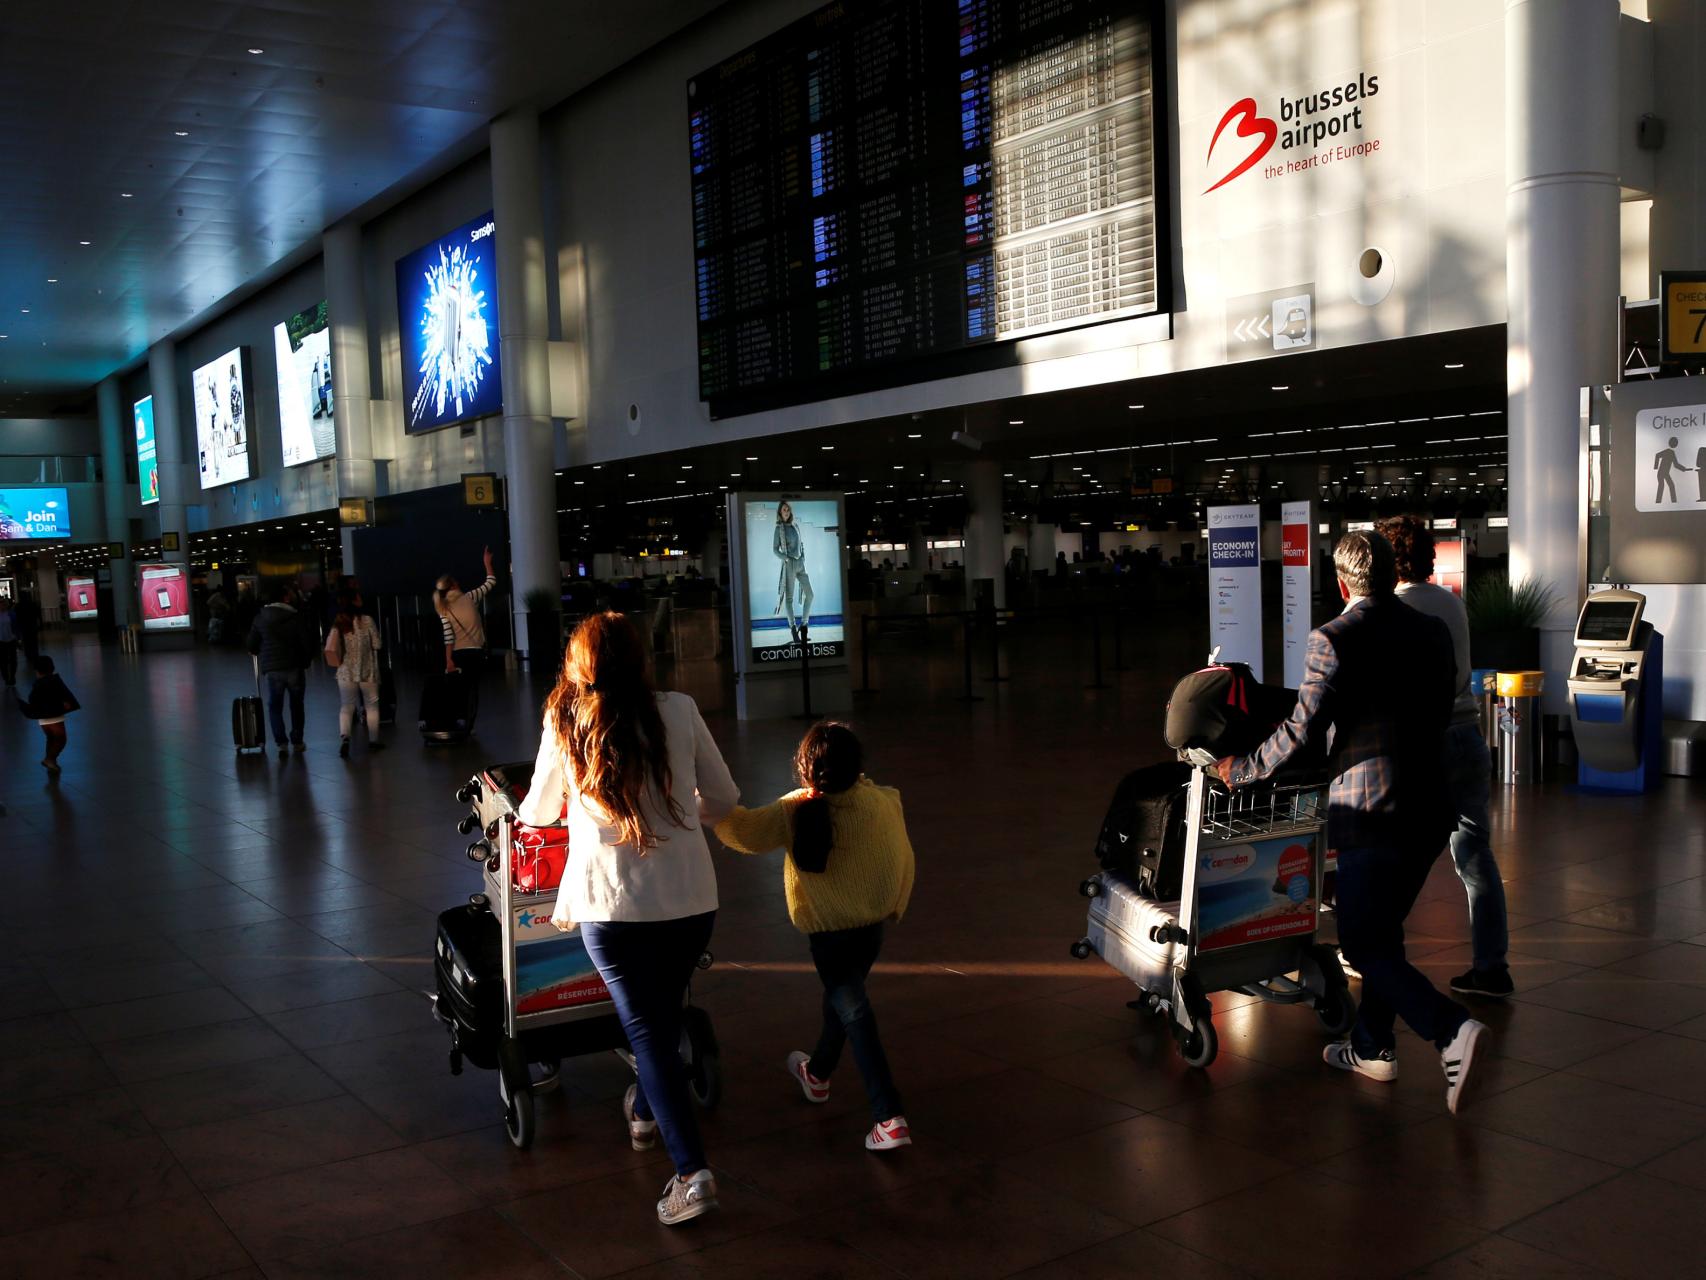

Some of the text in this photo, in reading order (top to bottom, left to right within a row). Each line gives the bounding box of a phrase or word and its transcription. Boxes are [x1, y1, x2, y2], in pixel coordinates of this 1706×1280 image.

[1281, 72, 1379, 122] brussels
[1281, 105, 1362, 150] airport
[1265, 139, 1380, 179] the heart of Europe
[1689, 309, 1706, 344] 7
[1652, 413, 1698, 430] Check
[475, 486, 485, 501] 6
[24, 510, 56, 522] Join
[0, 523, 57, 533] Sam & Dan
[1212, 541, 1255, 551] ECONOMY
[1212, 550, 1254, 559] CHECK-IN
[760, 644, 836, 661] carolin biss
